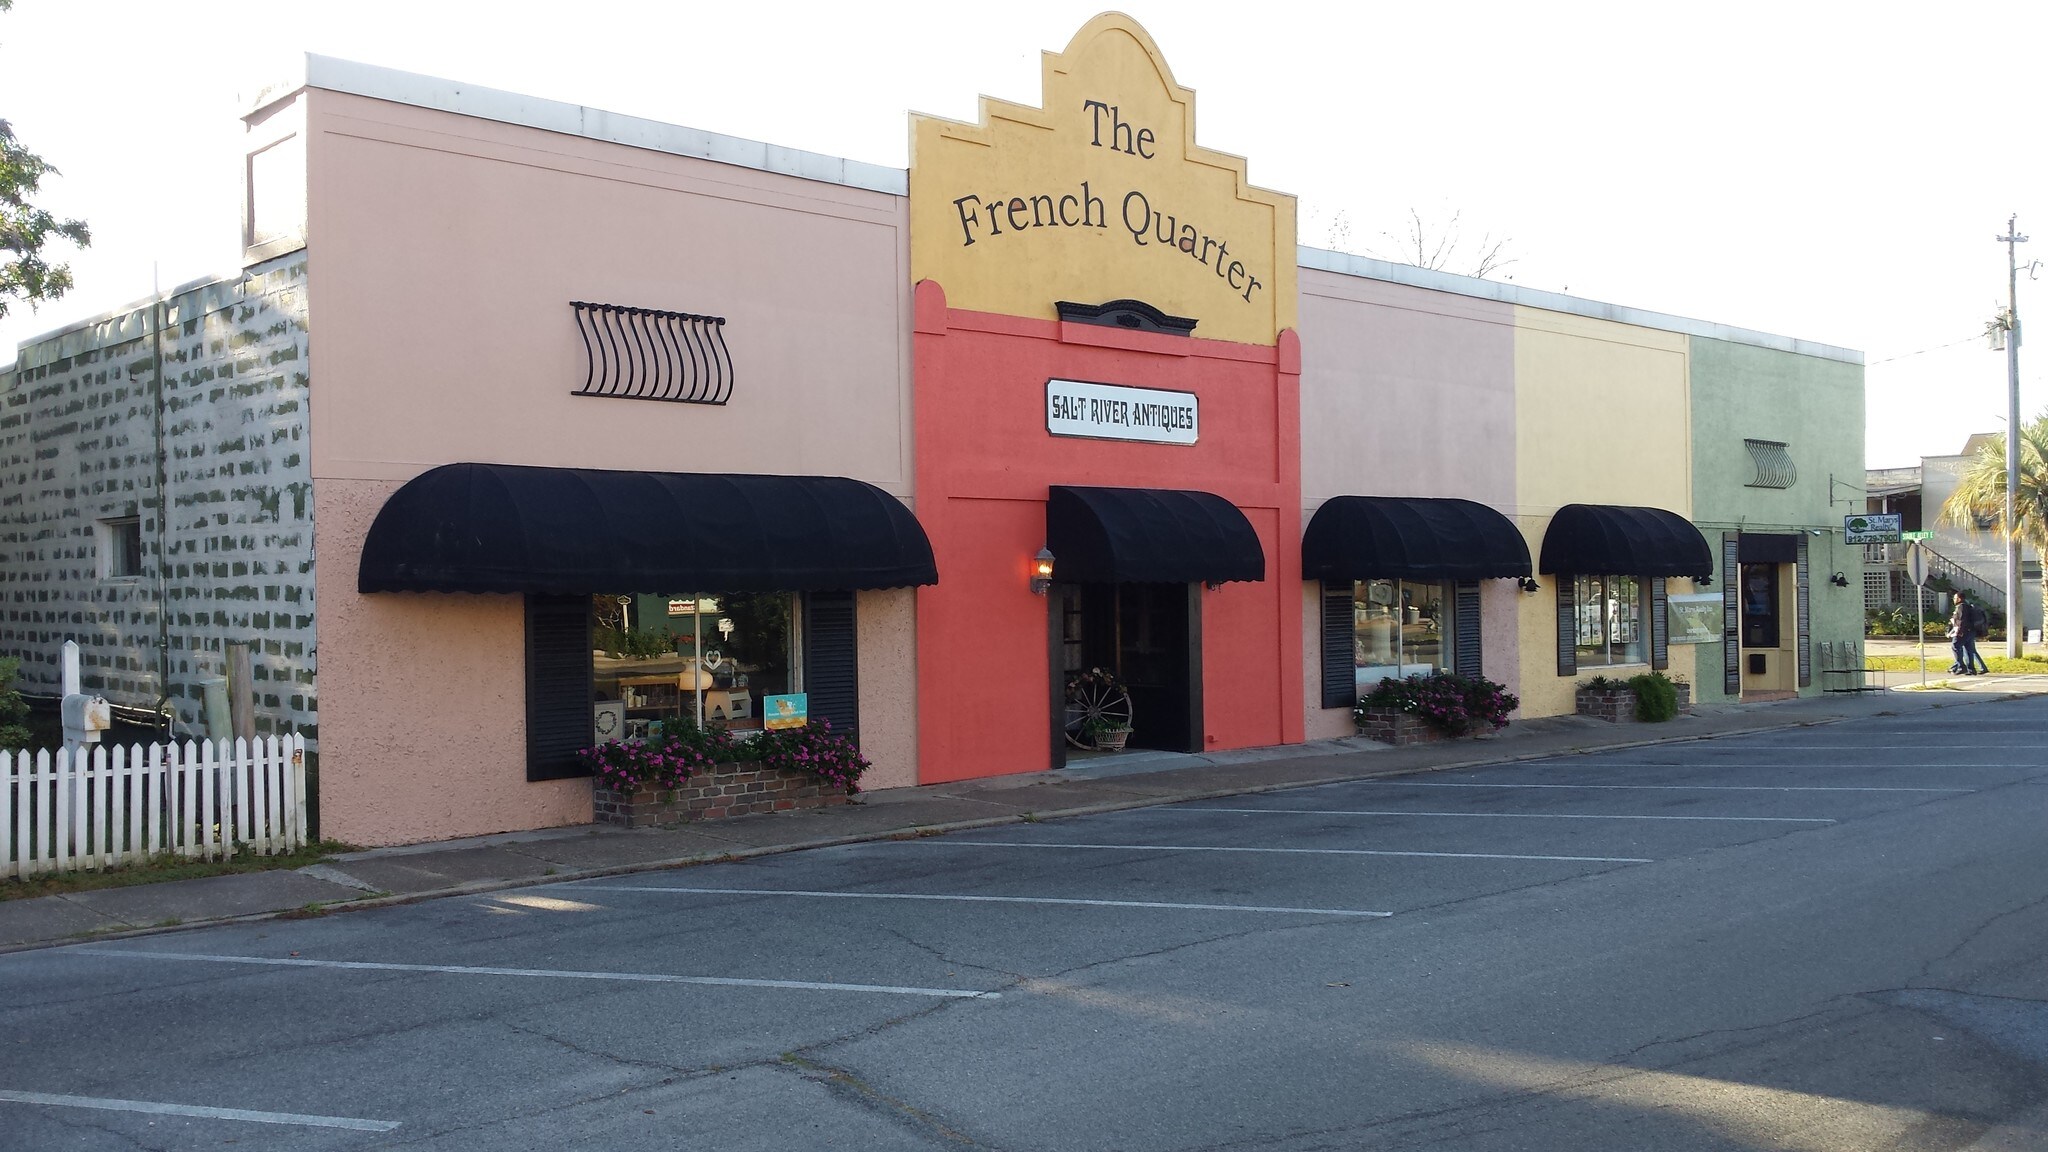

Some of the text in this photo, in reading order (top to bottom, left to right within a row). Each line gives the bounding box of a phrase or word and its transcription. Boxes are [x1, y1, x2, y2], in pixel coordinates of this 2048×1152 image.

[1083, 99, 1155, 160] The
[953, 180, 1262, 304] French Quarter
[1052, 394, 1194, 433] SALT RIVER ANTIQUES
[1848, 534, 1898, 543] 912-729-7900
